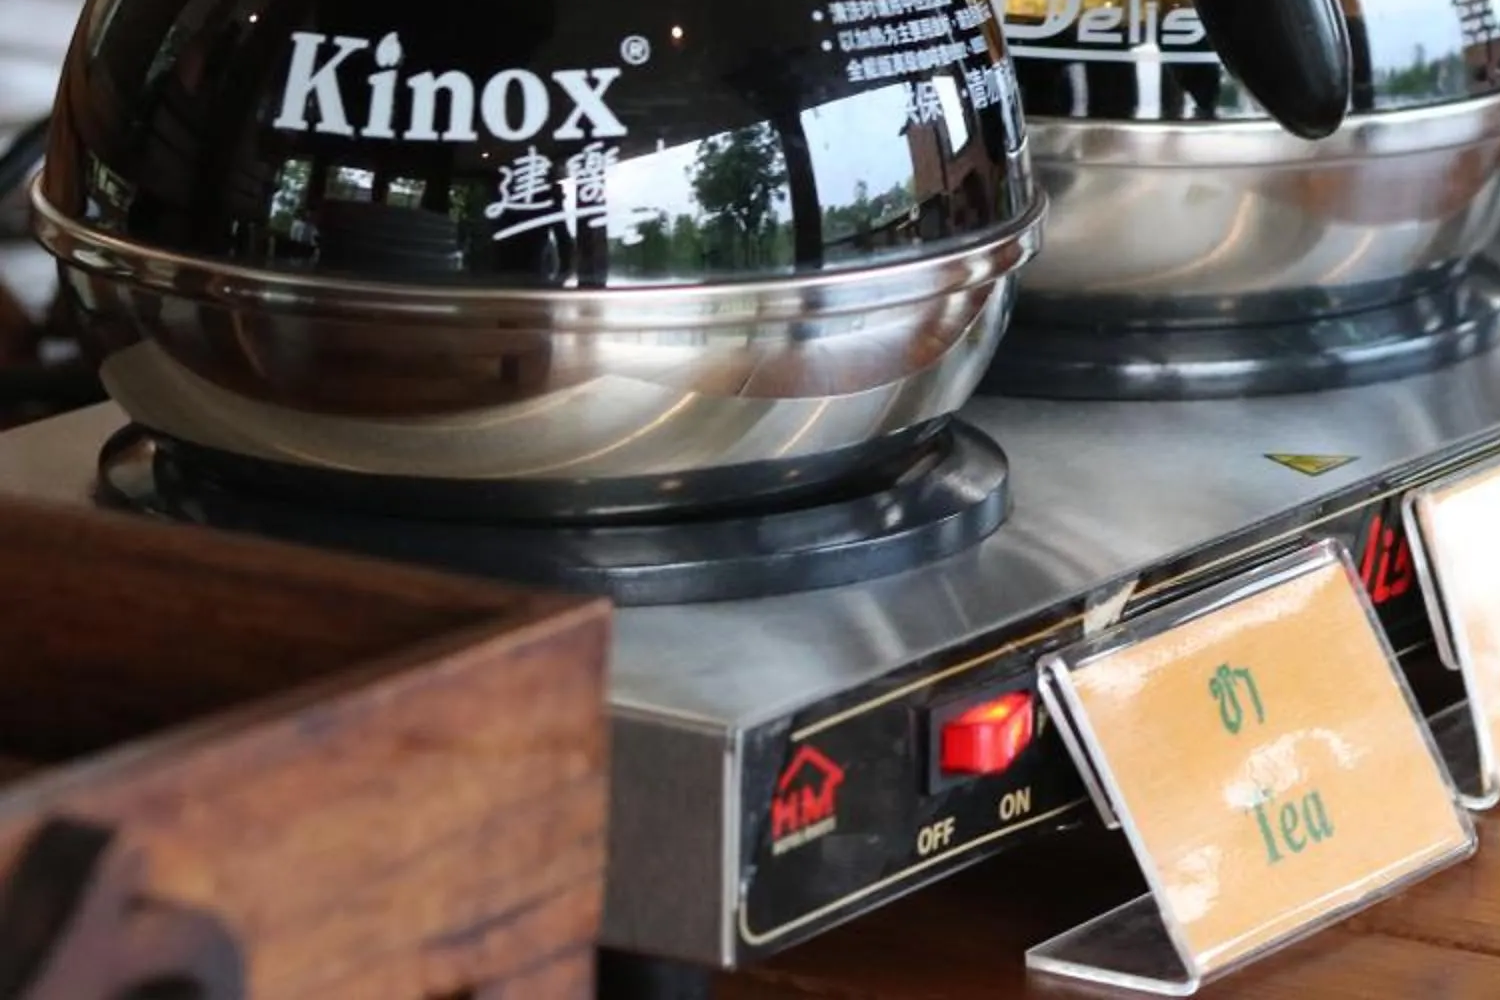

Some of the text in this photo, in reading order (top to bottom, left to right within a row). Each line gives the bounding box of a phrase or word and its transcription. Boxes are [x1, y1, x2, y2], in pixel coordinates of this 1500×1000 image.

[1208, 663, 1265, 735] ชา
[999, 786, 1031, 821] ON
[1244, 788, 1335, 865] Tea
[916, 817, 955, 856] OFF
